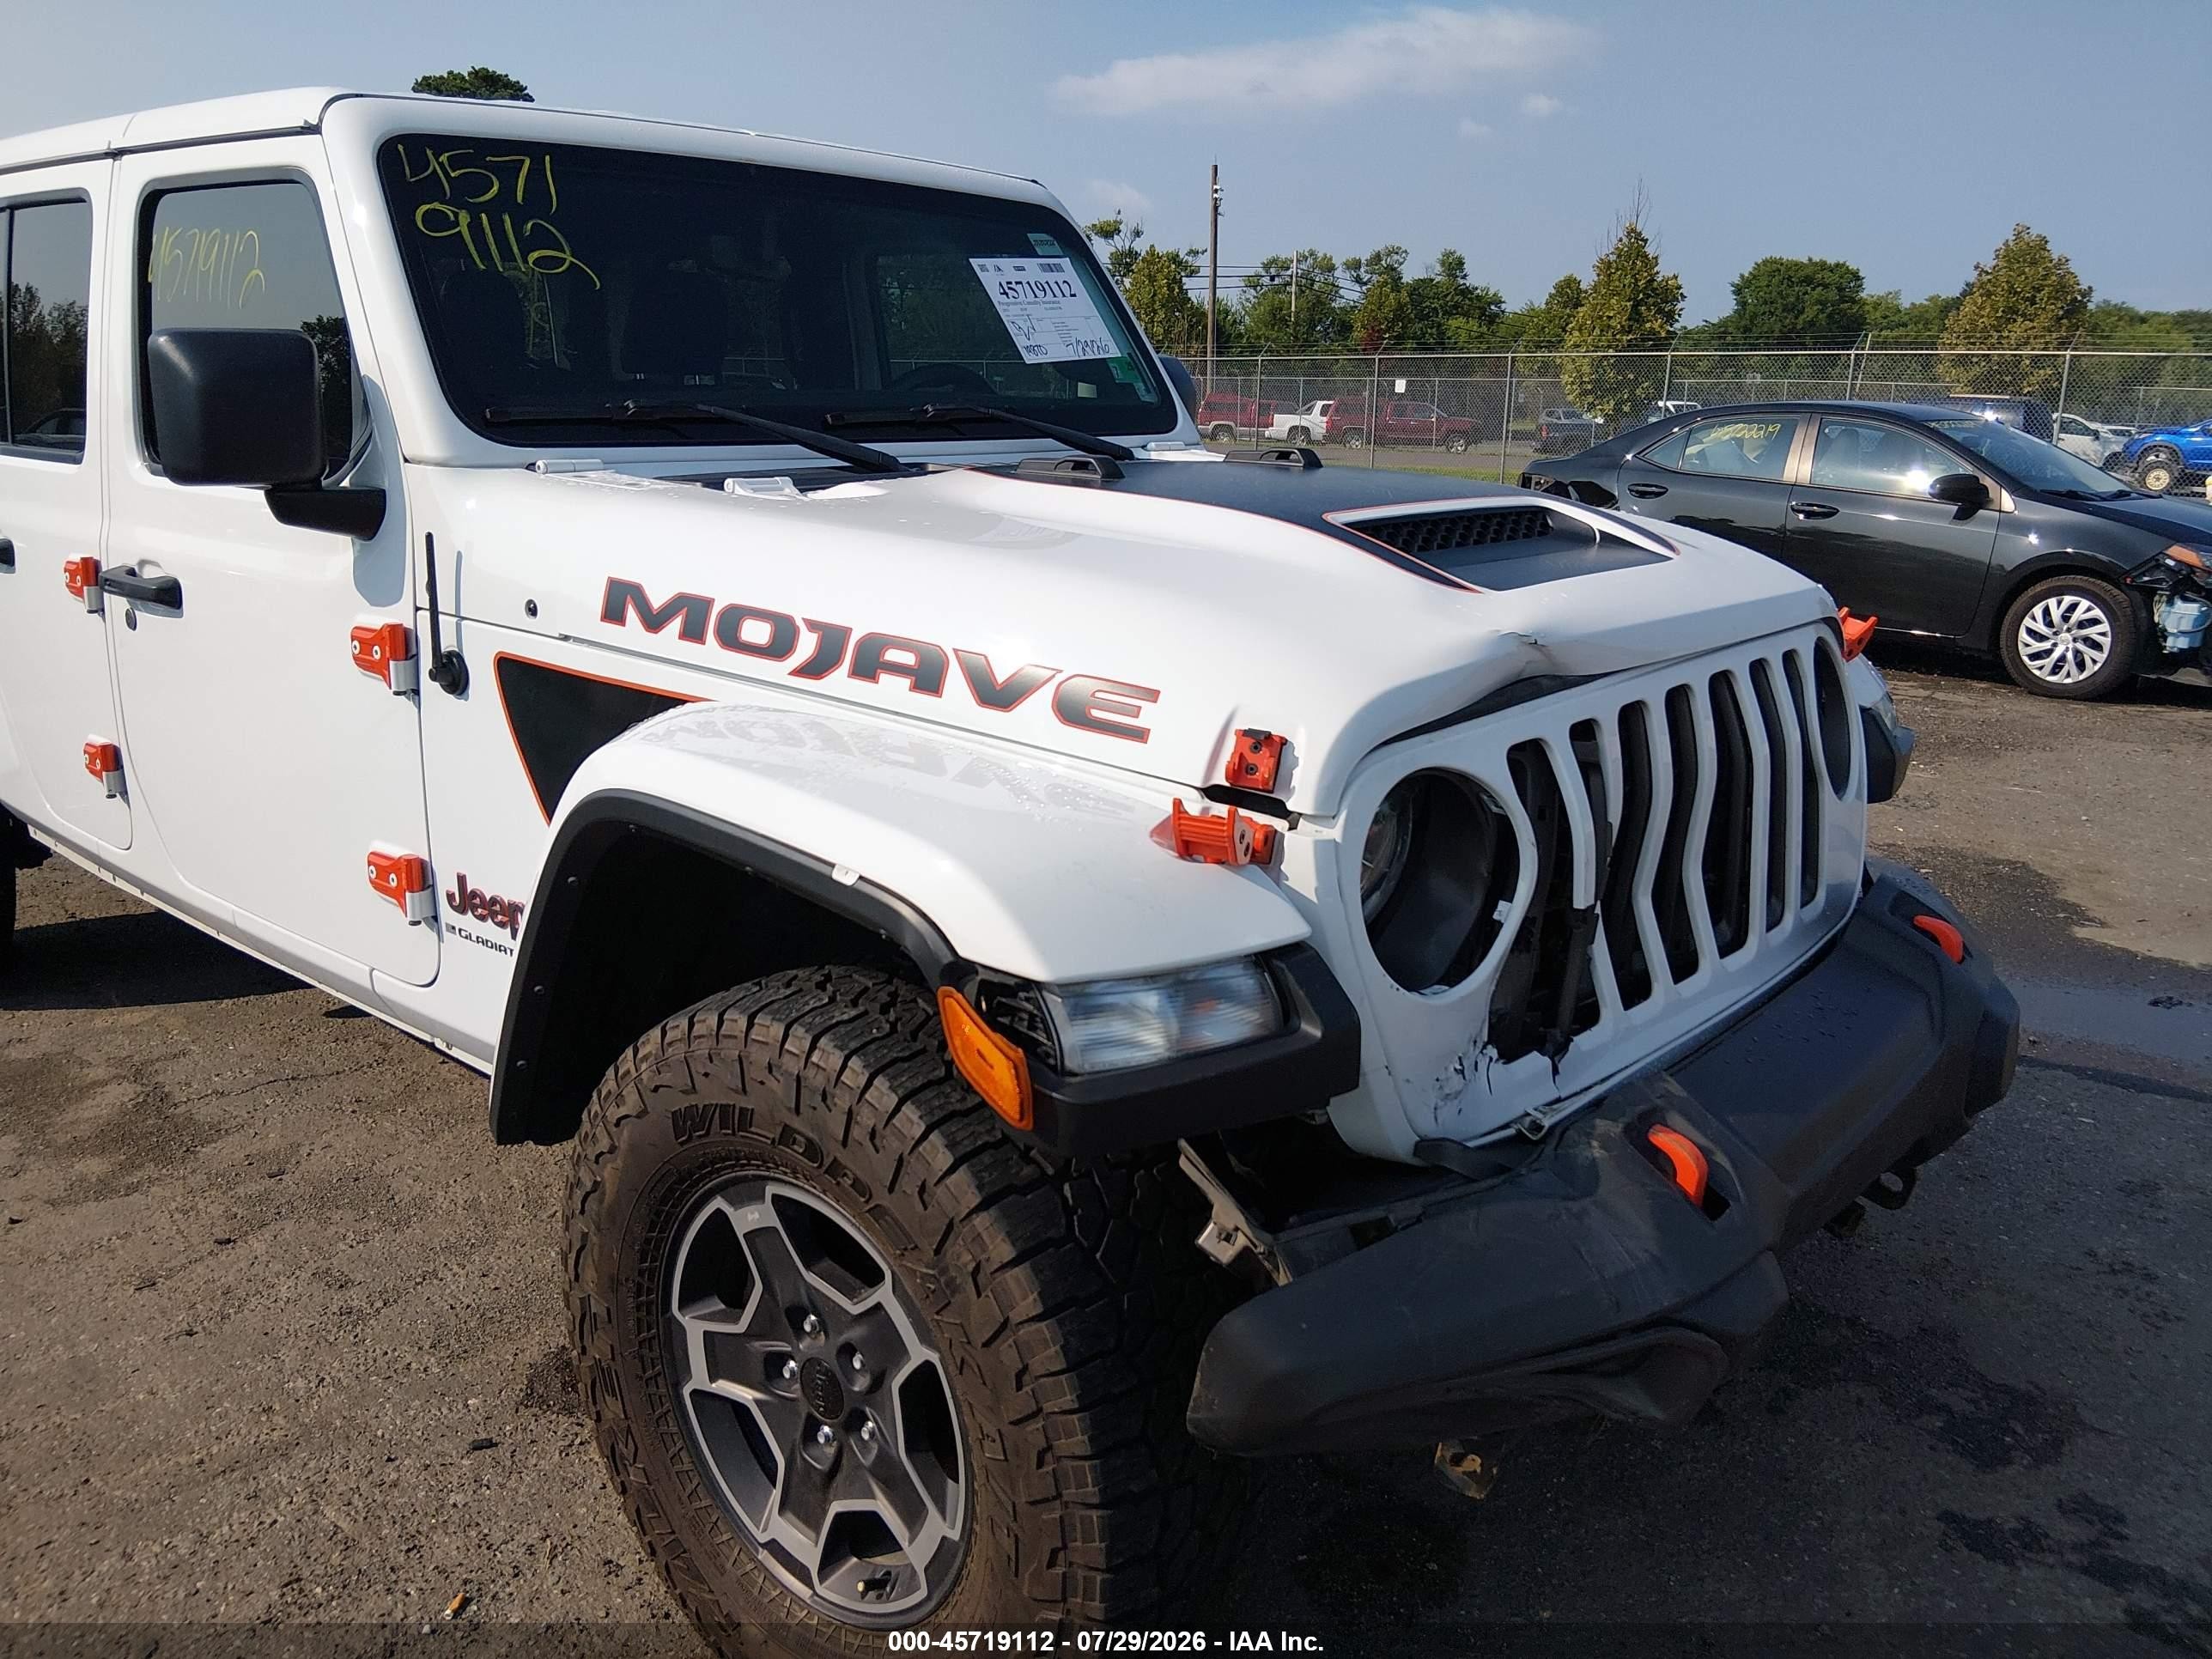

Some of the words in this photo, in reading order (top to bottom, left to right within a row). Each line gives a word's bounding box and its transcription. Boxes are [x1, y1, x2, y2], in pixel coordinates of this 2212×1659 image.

[397, 143, 557, 216] 4571
[148, 226, 265, 310] 45719112
[415, 202, 601, 290] 9112
[998, 280, 1078, 300] 45719112
[599, 576, 1161, 744] MOJAVE
